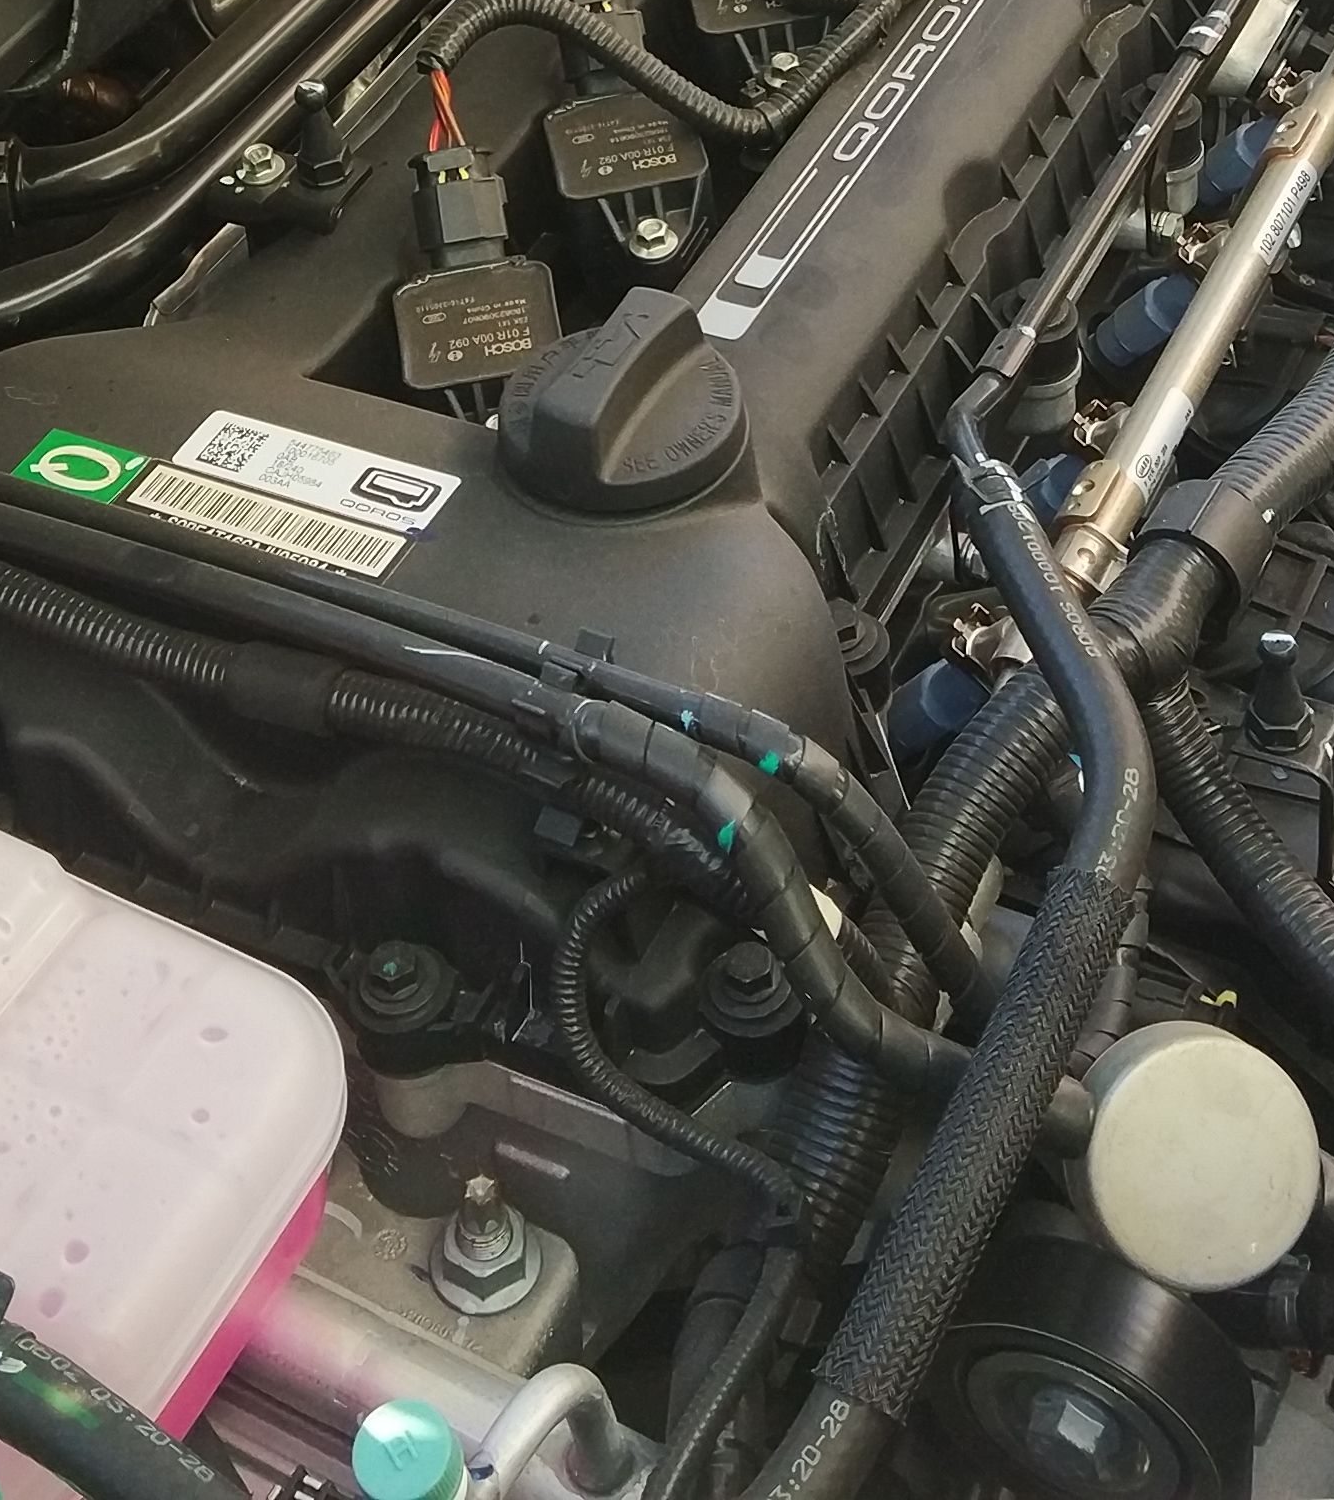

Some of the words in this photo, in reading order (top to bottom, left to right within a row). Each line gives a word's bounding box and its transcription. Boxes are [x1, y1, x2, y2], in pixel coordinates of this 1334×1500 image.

[642, 145, 664, 155] 01R
[666, 142, 674, 151] F
[598, 154, 618, 165] 092
[618, 149, 641, 160] 00A
[631, 153, 677, 170] BOSCH
[1258, 232, 1276, 255] 102
[1267, 196, 1297, 236] 807101
[1288, 169, 1311, 200] P498
[495, 327, 519, 340] 01R
[521, 326, 530, 335] F
[448, 337, 469, 349] 092
[470, 332, 494, 344] 00A
[483, 337, 532, 356] BOSCH
[623, 456, 660, 473] SEE
[698, 356, 734, 408] MANUAL
[338, 497, 418, 527] QOROS
[1057, 597, 1102, 662] QOROS
[88, 1382, 216, 1484] 03:20-28
